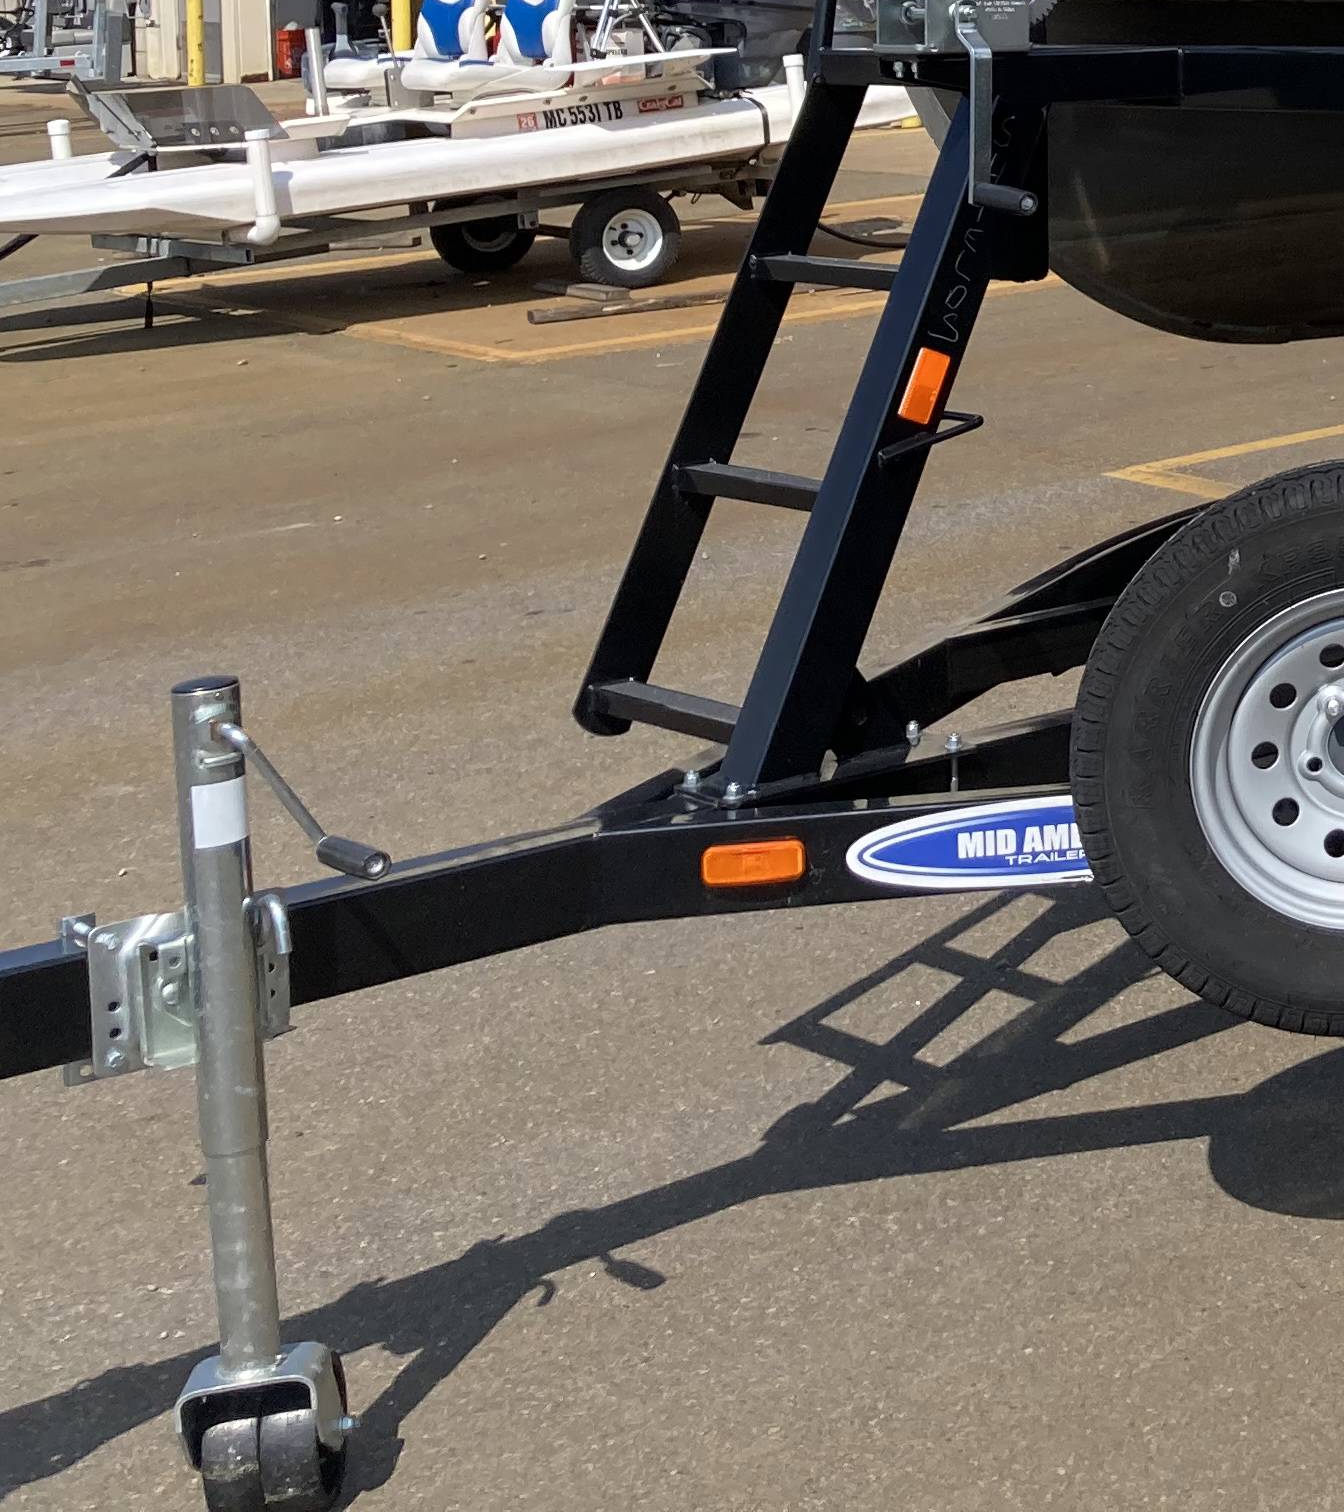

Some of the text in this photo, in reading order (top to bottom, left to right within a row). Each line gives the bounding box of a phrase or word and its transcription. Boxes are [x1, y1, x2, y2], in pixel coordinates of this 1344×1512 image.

[543, 100, 623, 129] MC 5531 TB
[957, 829, 1017, 859] MID
